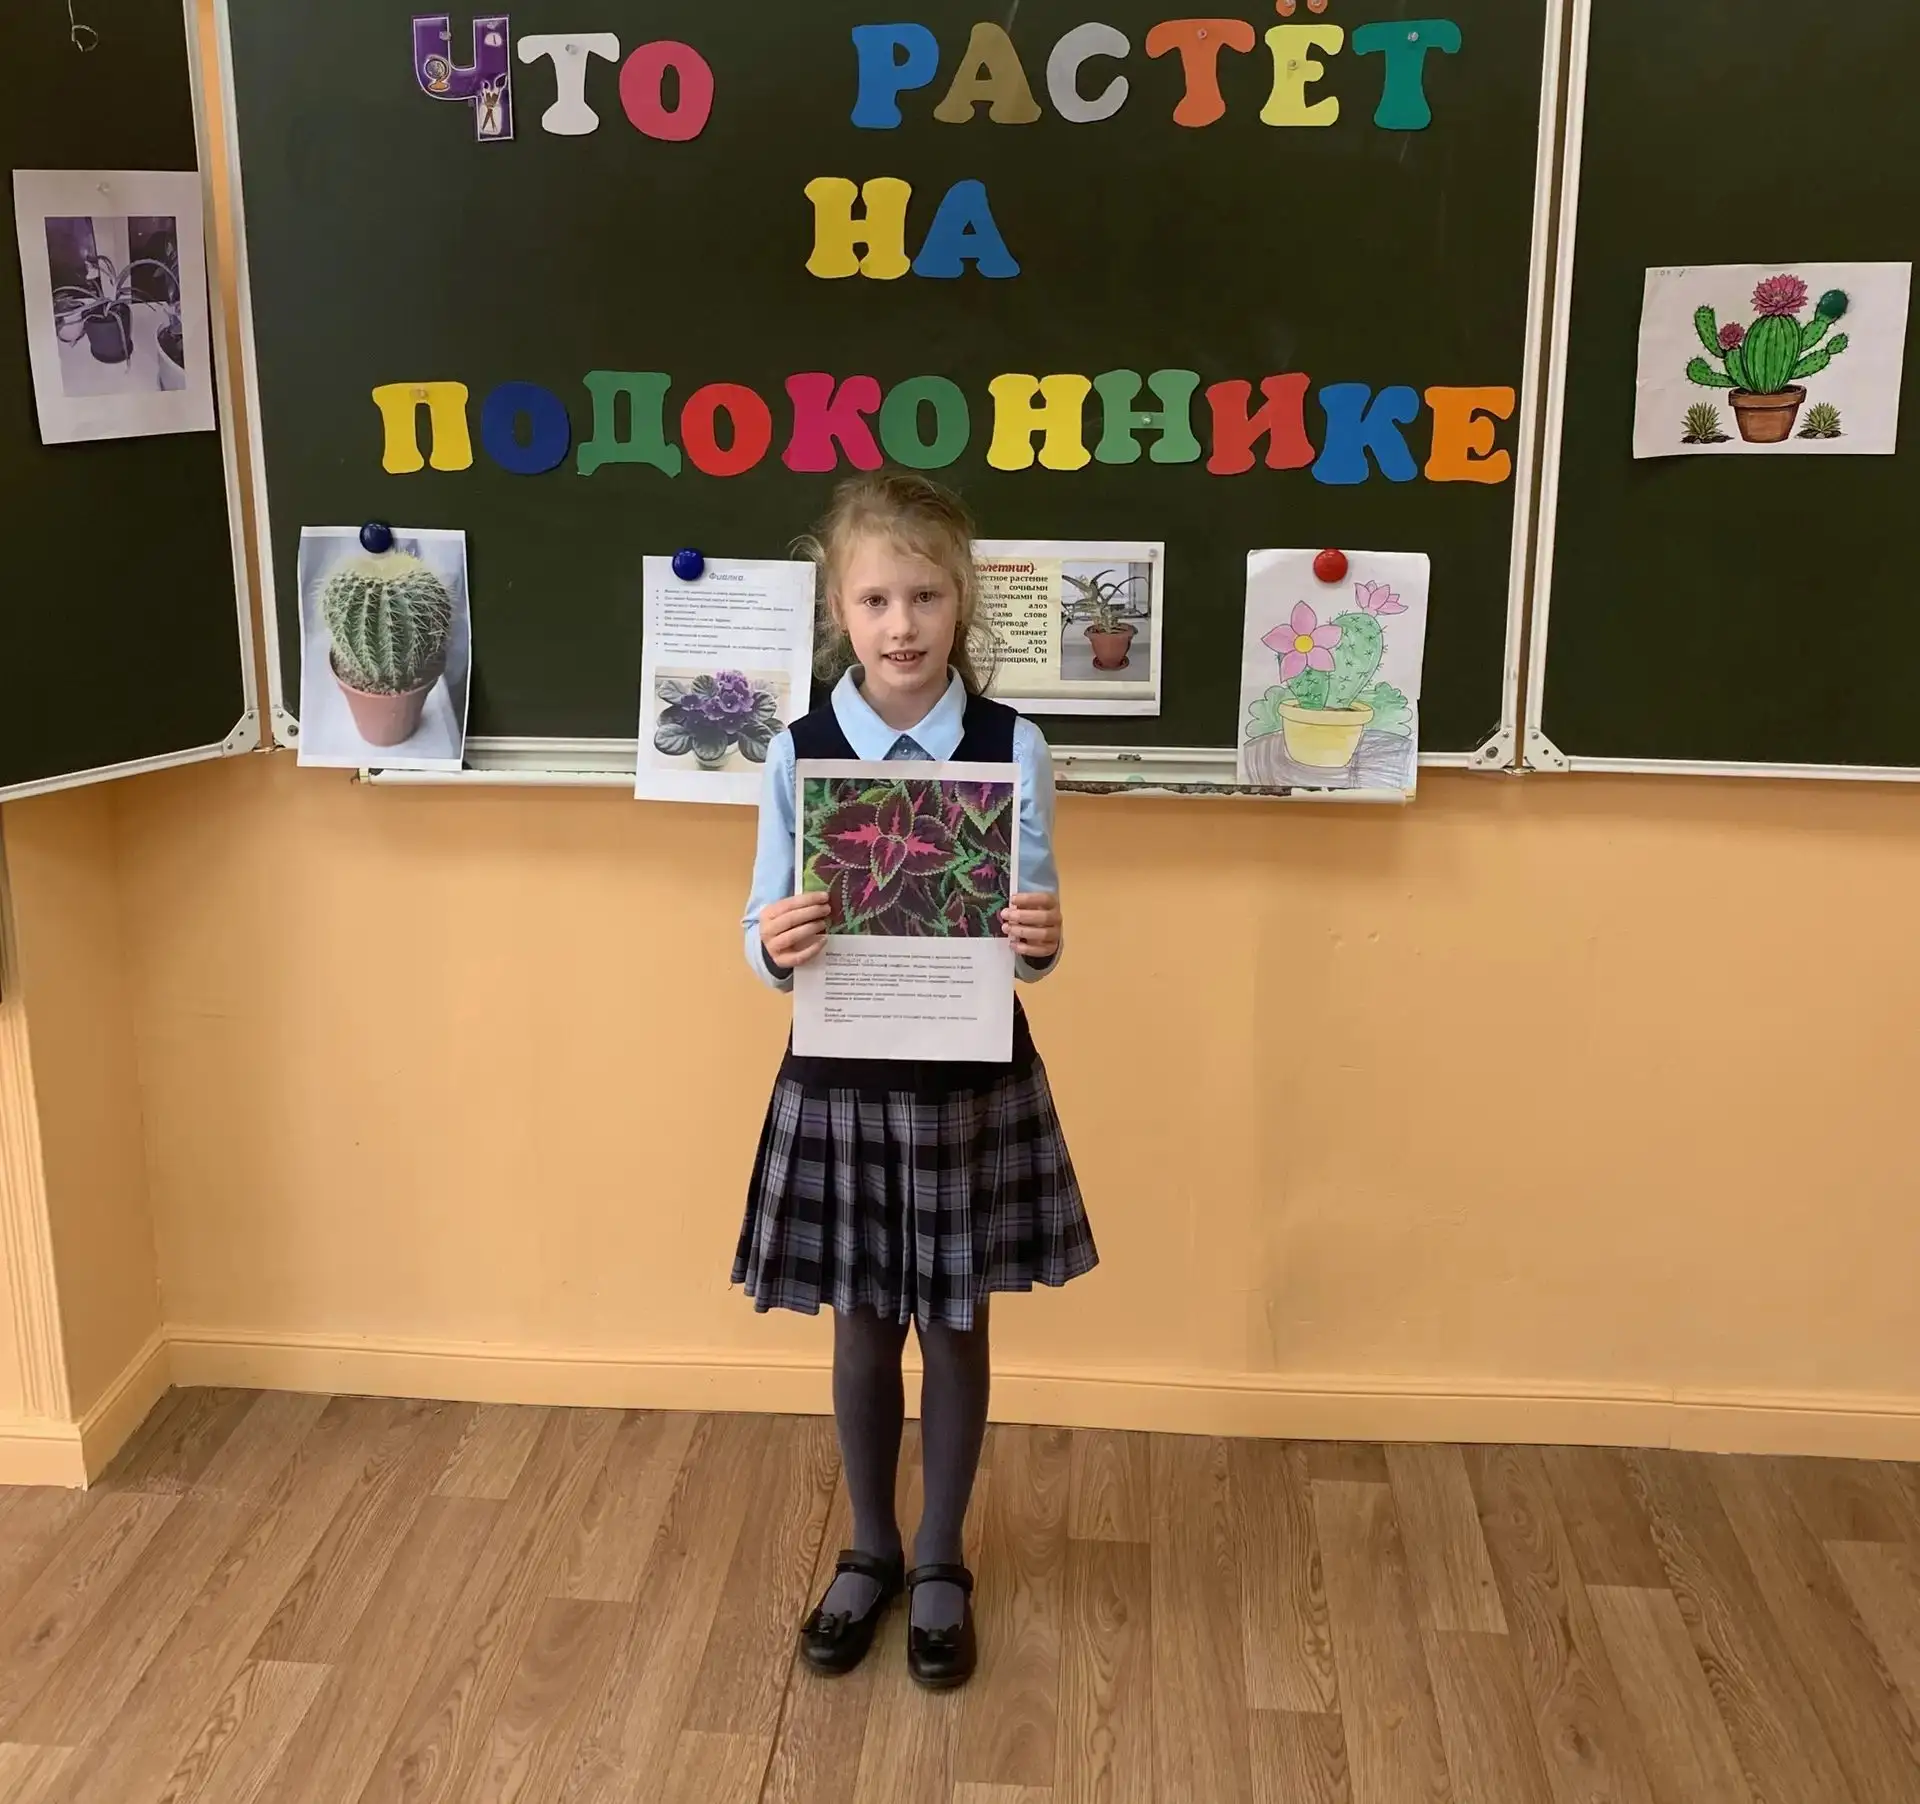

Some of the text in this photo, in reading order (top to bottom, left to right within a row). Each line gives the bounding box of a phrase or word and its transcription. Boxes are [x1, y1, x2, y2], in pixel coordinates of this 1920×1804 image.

[412, 0, 1462, 141] ЧТО РАСТЁТ
[804, 177, 1021, 280] НА
[372, 369, 1516, 485] ПОДОКОННИКЕ
[1010, 575, 1048, 583] растение
[1034, 646, 1047, 654] Он
